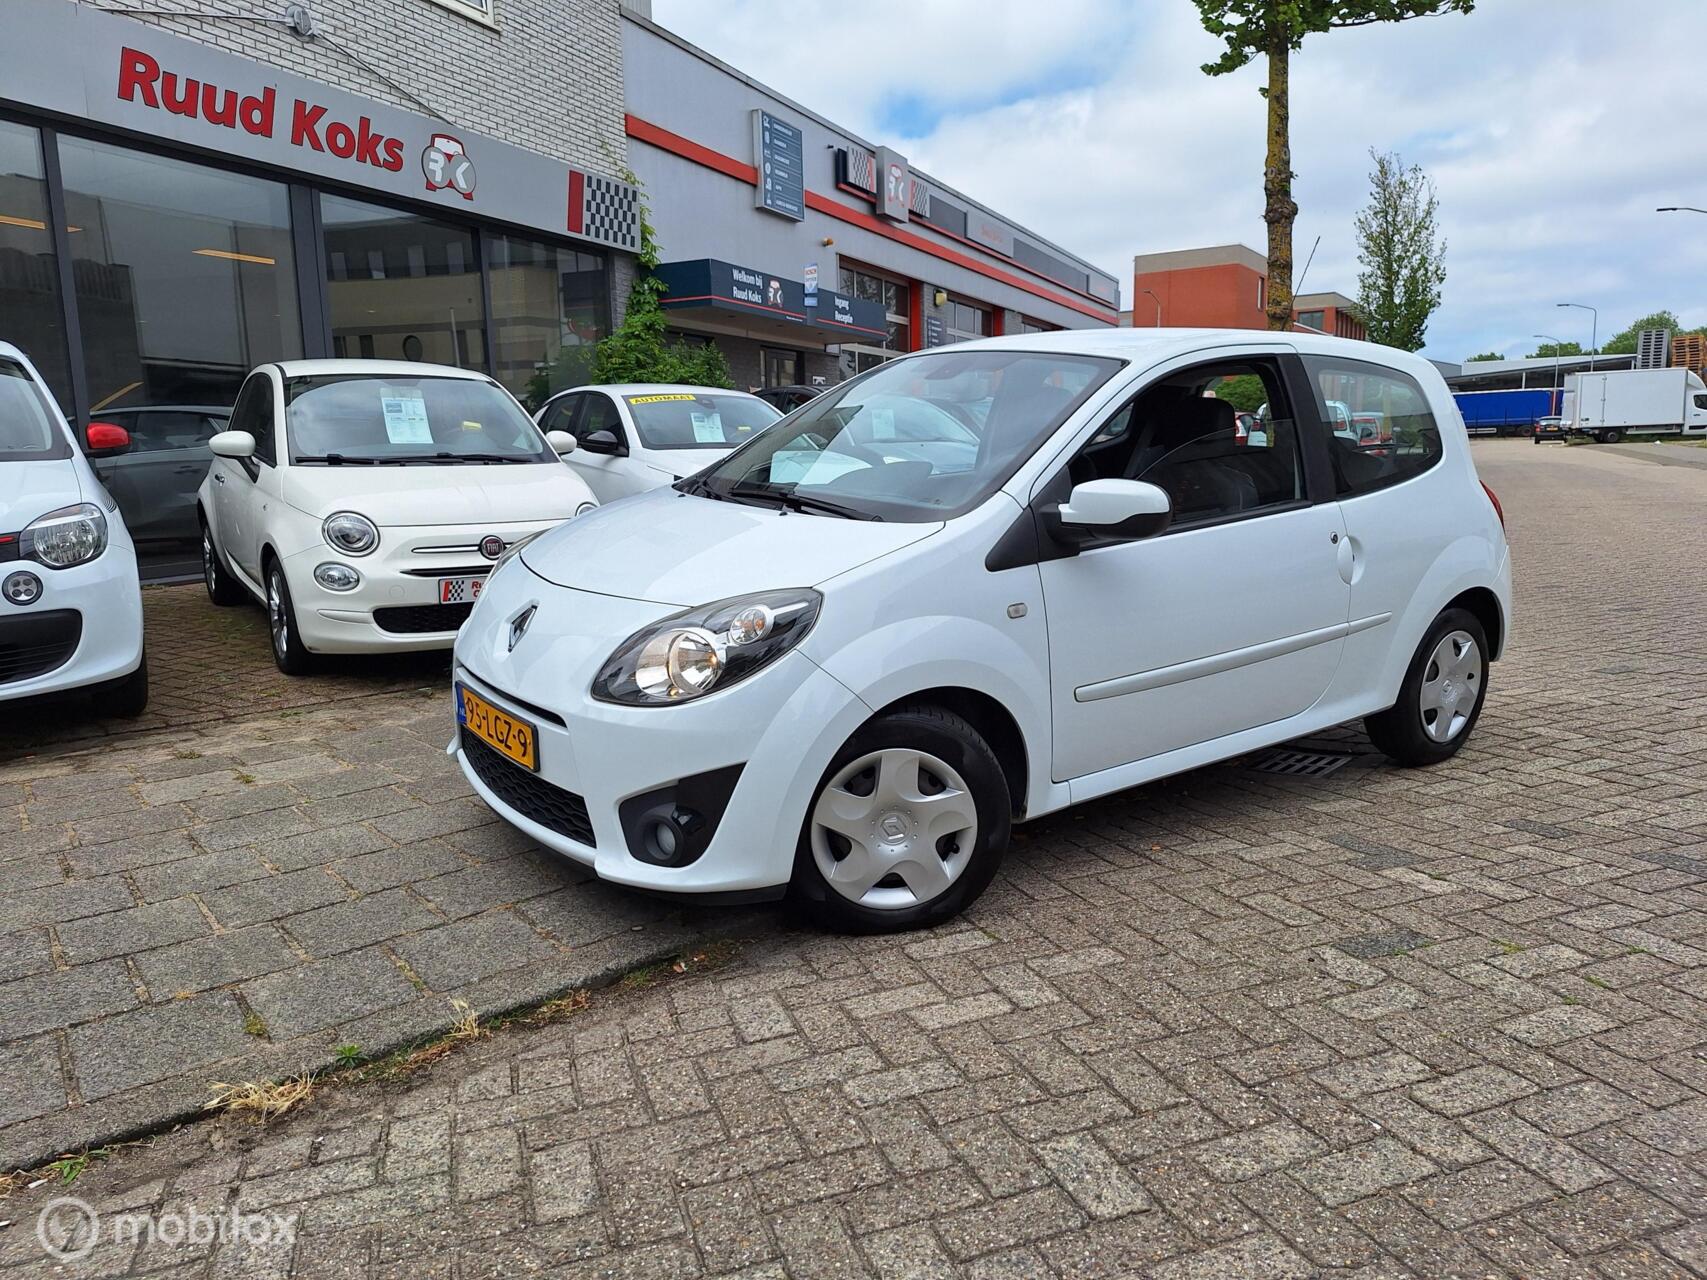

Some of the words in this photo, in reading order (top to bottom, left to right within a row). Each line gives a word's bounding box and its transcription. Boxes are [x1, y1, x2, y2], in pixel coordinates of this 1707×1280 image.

[117, 46, 277, 138] Ruud
[290, 98, 404, 173] Koks
[732, 267, 755, 285] Welkom
[755, 274, 763, 290] bij
[732, 285, 748, 300] Ruud
[748, 289, 762, 304] Koks
[634, 394, 692, 405] AUTOMAAT
[486, 543, 499, 553] FIAT
[465, 696, 529, 758] 95-LGZ-9
